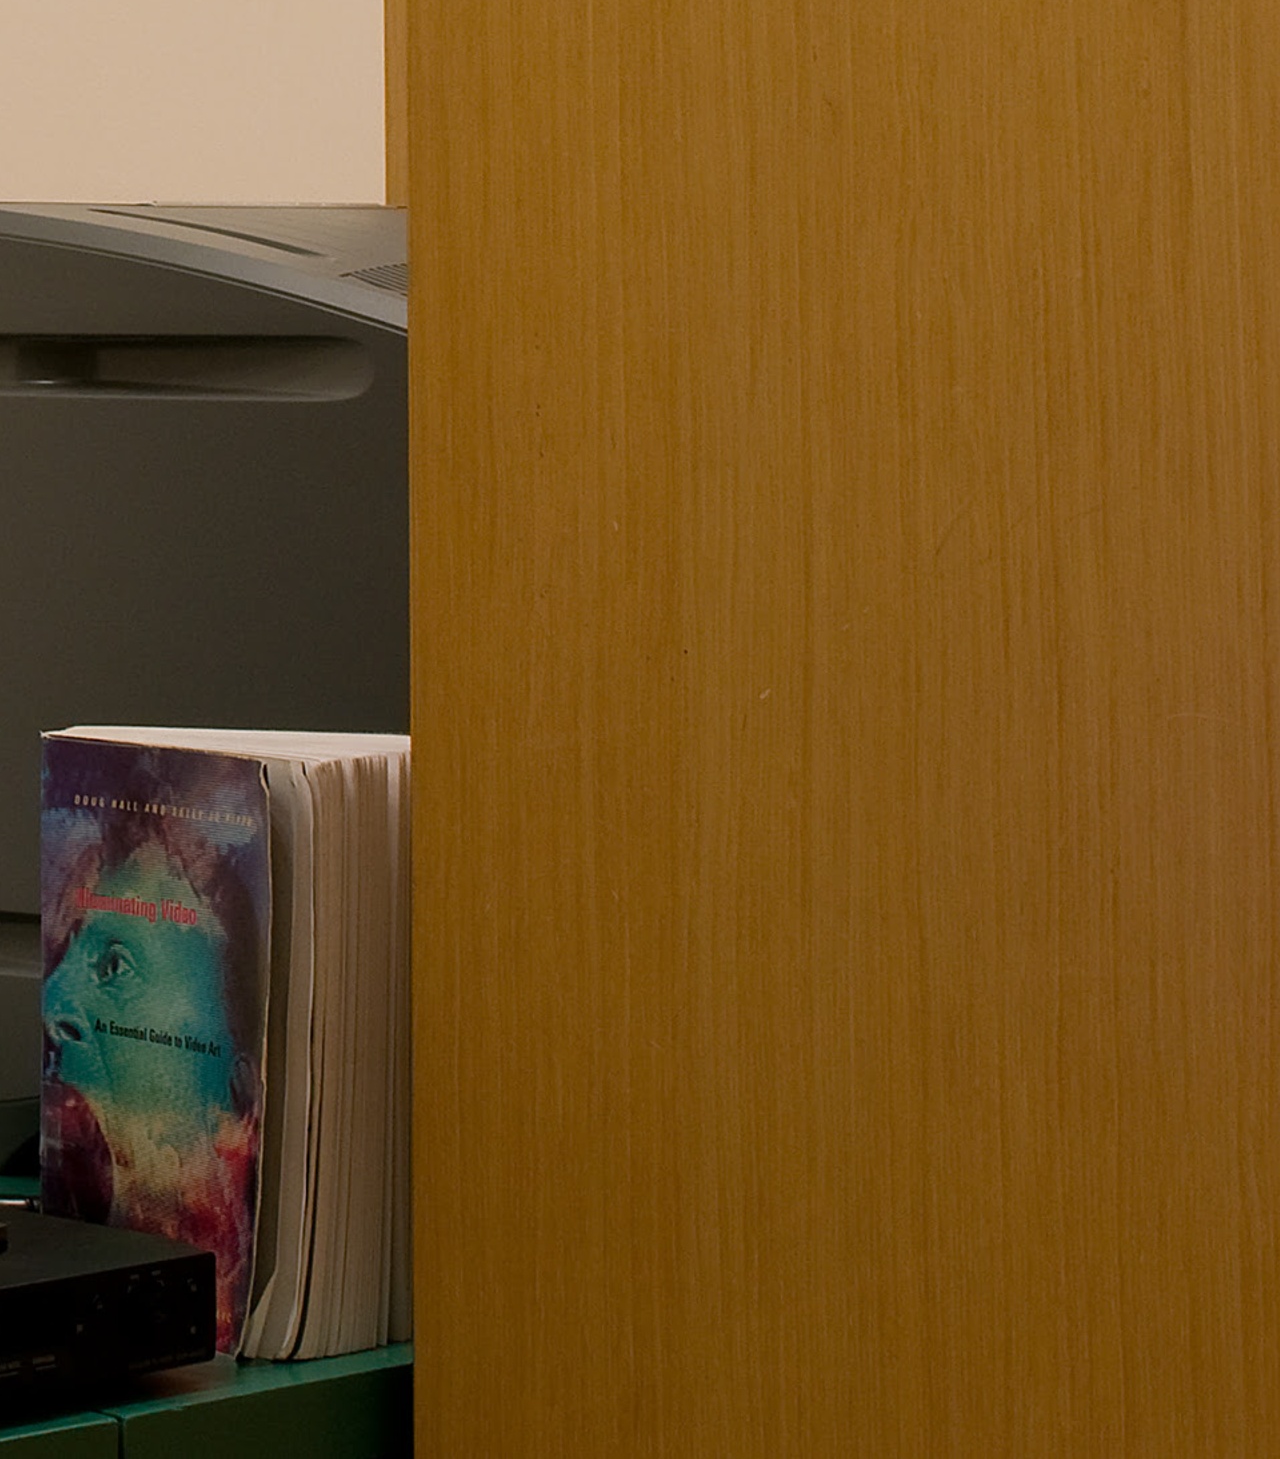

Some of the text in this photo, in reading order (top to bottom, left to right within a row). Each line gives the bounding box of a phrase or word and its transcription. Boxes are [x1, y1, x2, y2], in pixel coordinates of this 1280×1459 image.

[73, 794, 106, 809] DOUG
[111, 798, 139, 812] HALL
[144, 802, 166, 817] AND
[161, 898, 198, 926] Video
[95, 1018, 107, 1034] An
[109, 1020, 148, 1041] Essential
[149, 1028, 173, 1047] Guide
[184, 1035, 207, 1054] Video
